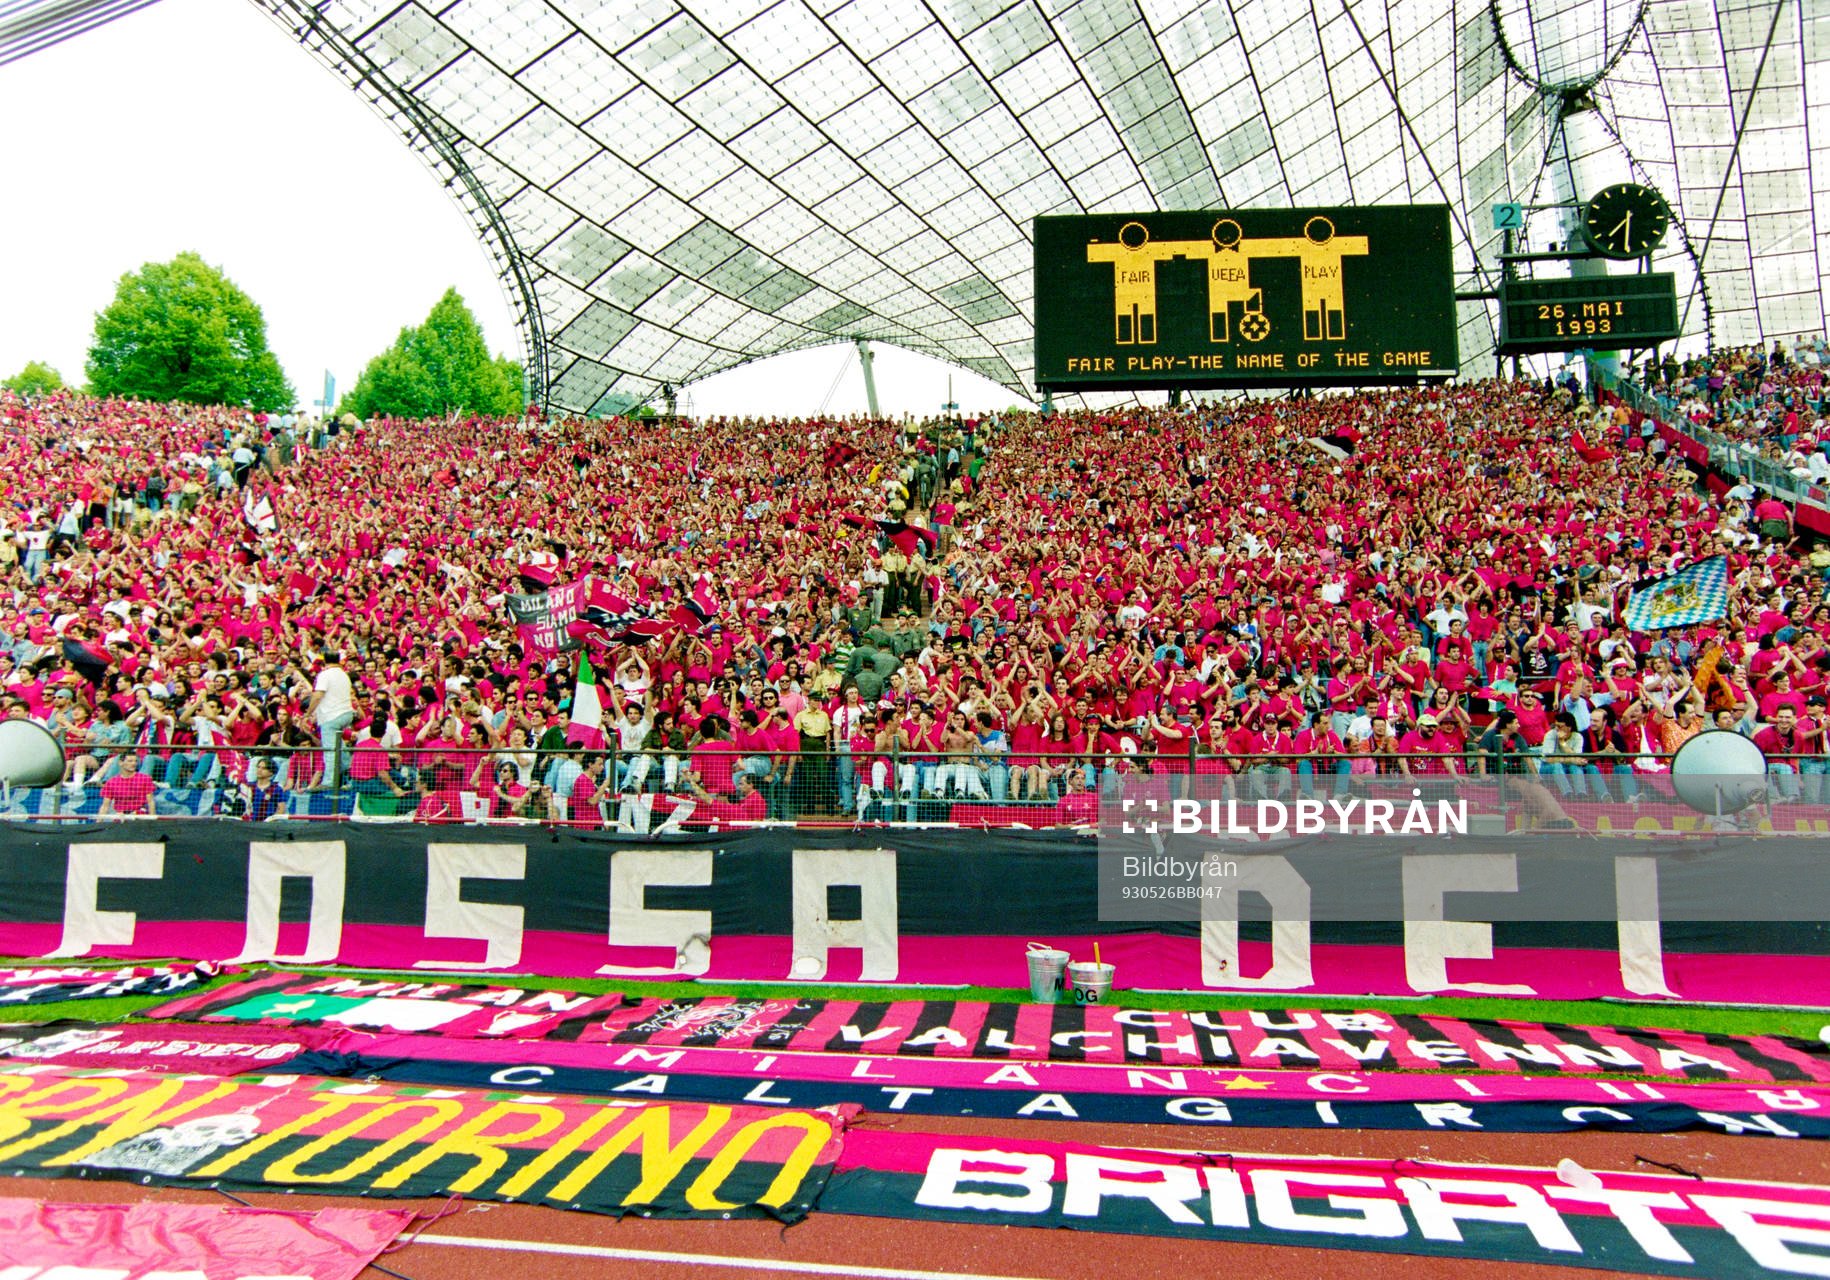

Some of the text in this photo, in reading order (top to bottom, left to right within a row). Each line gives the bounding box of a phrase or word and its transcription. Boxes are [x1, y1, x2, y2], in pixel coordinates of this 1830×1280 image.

[1500, 206, 1517, 227] 2
[1121, 270, 1151, 285] FAIR
[1304, 265, 1339, 279] PLAY
[1538, 301, 1624, 319] 26.MAI
[1556, 319, 1611, 335] 1993
[1068, 358, 1115, 372] FAIR
[1236, 354, 1284, 369] NAME
[1298, 353, 1321, 367] OF
[1335, 353, 1370, 366] THE
[1384, 352, 1432, 366] GAME
[521, 588, 575, 611] MILANO
[536, 606, 577, 631] SIAMO
[44, 840, 900, 981] FOSSA
[308, 979, 1393, 1032] MILAN CLUB
[840, 1025, 1741, 1073] VALCHIAVENNA
[613, 1048, 1188, 1090] MILAN
[186, 1093, 833, 1211] TORINO
[915, 1148, 1830, 1279] BRIGATE
